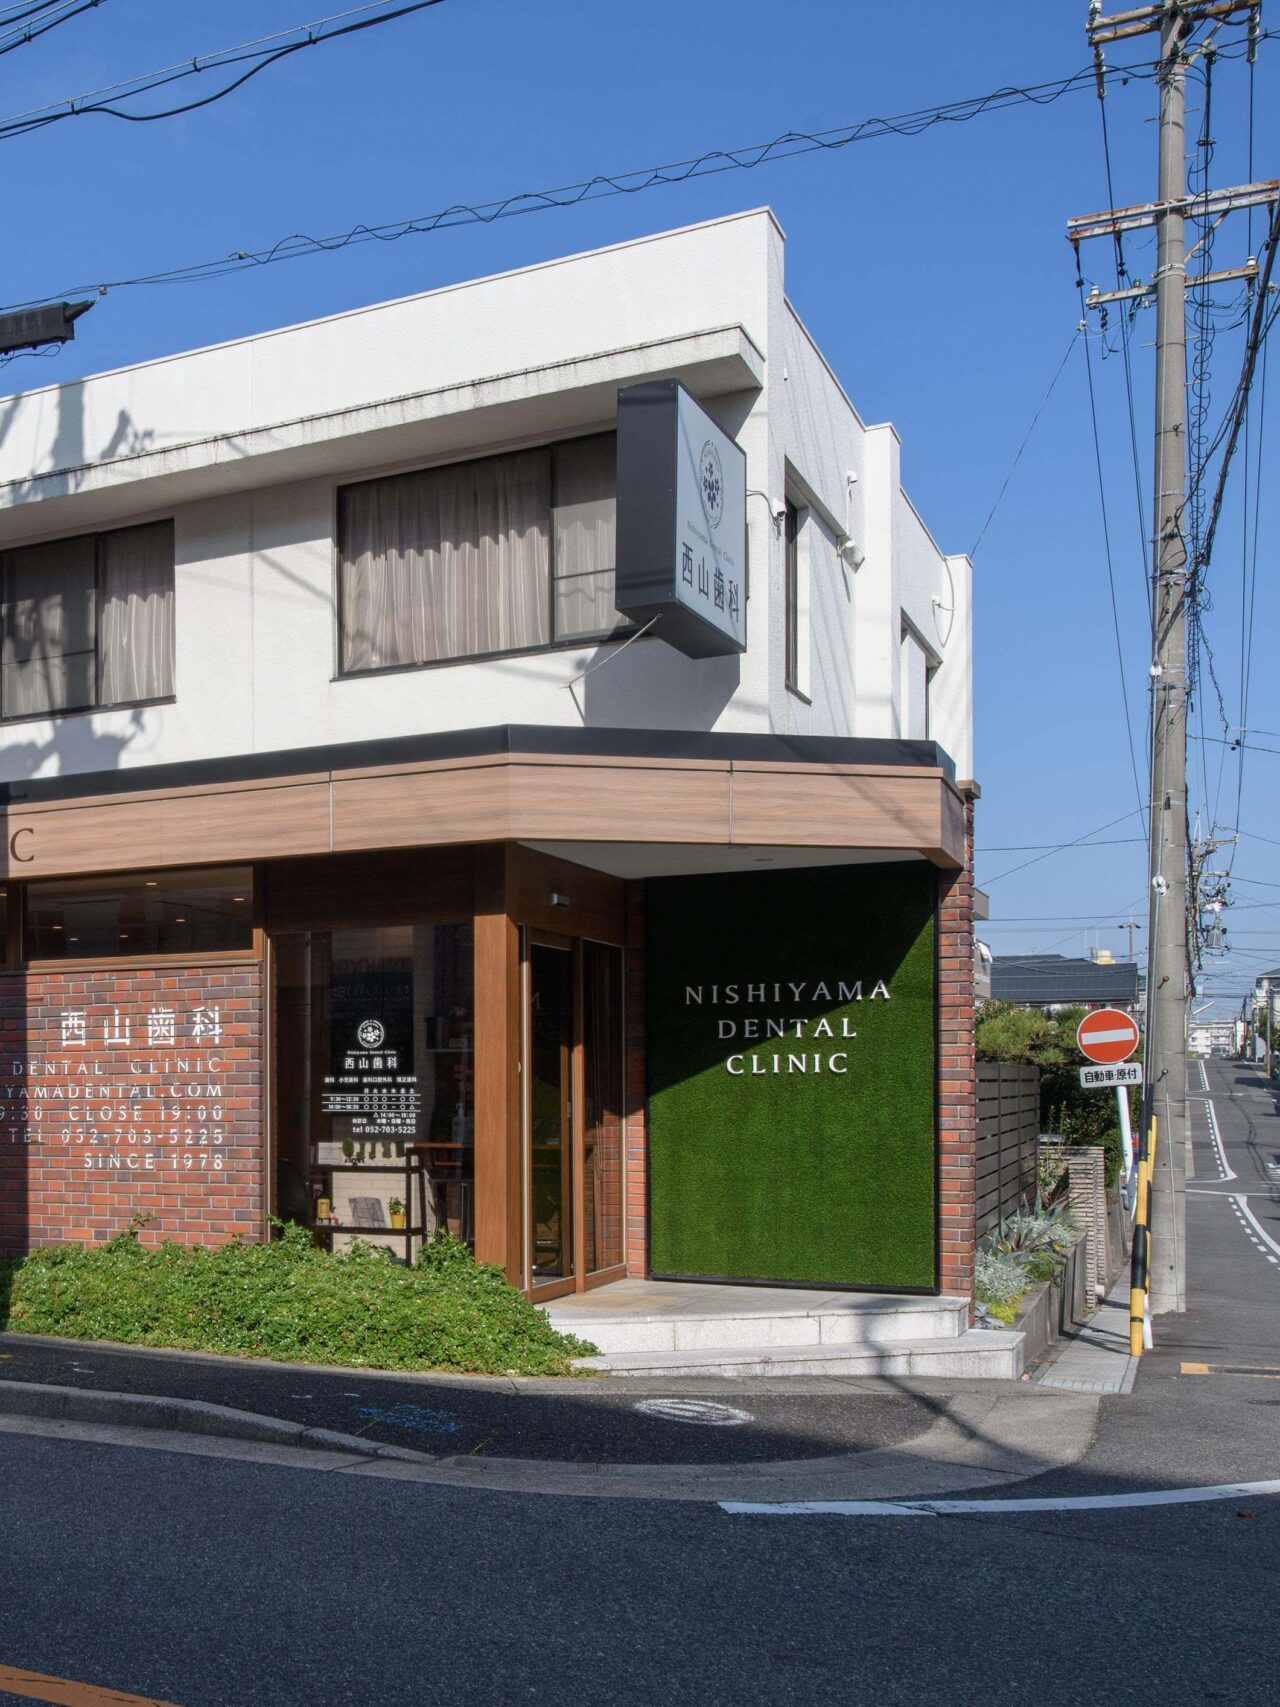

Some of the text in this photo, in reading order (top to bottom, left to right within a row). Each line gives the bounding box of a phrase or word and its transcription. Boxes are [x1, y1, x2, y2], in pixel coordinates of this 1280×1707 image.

[681, 541, 739, 624] 西山歯科
[684, 979, 892, 1005] NISHIYAMA
[60, 1006, 223, 1047] 西山歯科
[718, 1017, 858, 1039] DENTAL
[12, 1060, 104, 1077] DENTAL
[130, 1057, 221, 1075] CLINIC
[345, 1057, 397, 1069] 西山歯科
[726, 1053, 849, 1075] CLINIC
[69, 1105, 143, 1121] CLOSE
[160, 1104, 223, 1121] 19:00
[8, 1127, 223, 1145] TEL 052-703-5225
[84, 1152, 223, 1170] SINCE 1978
